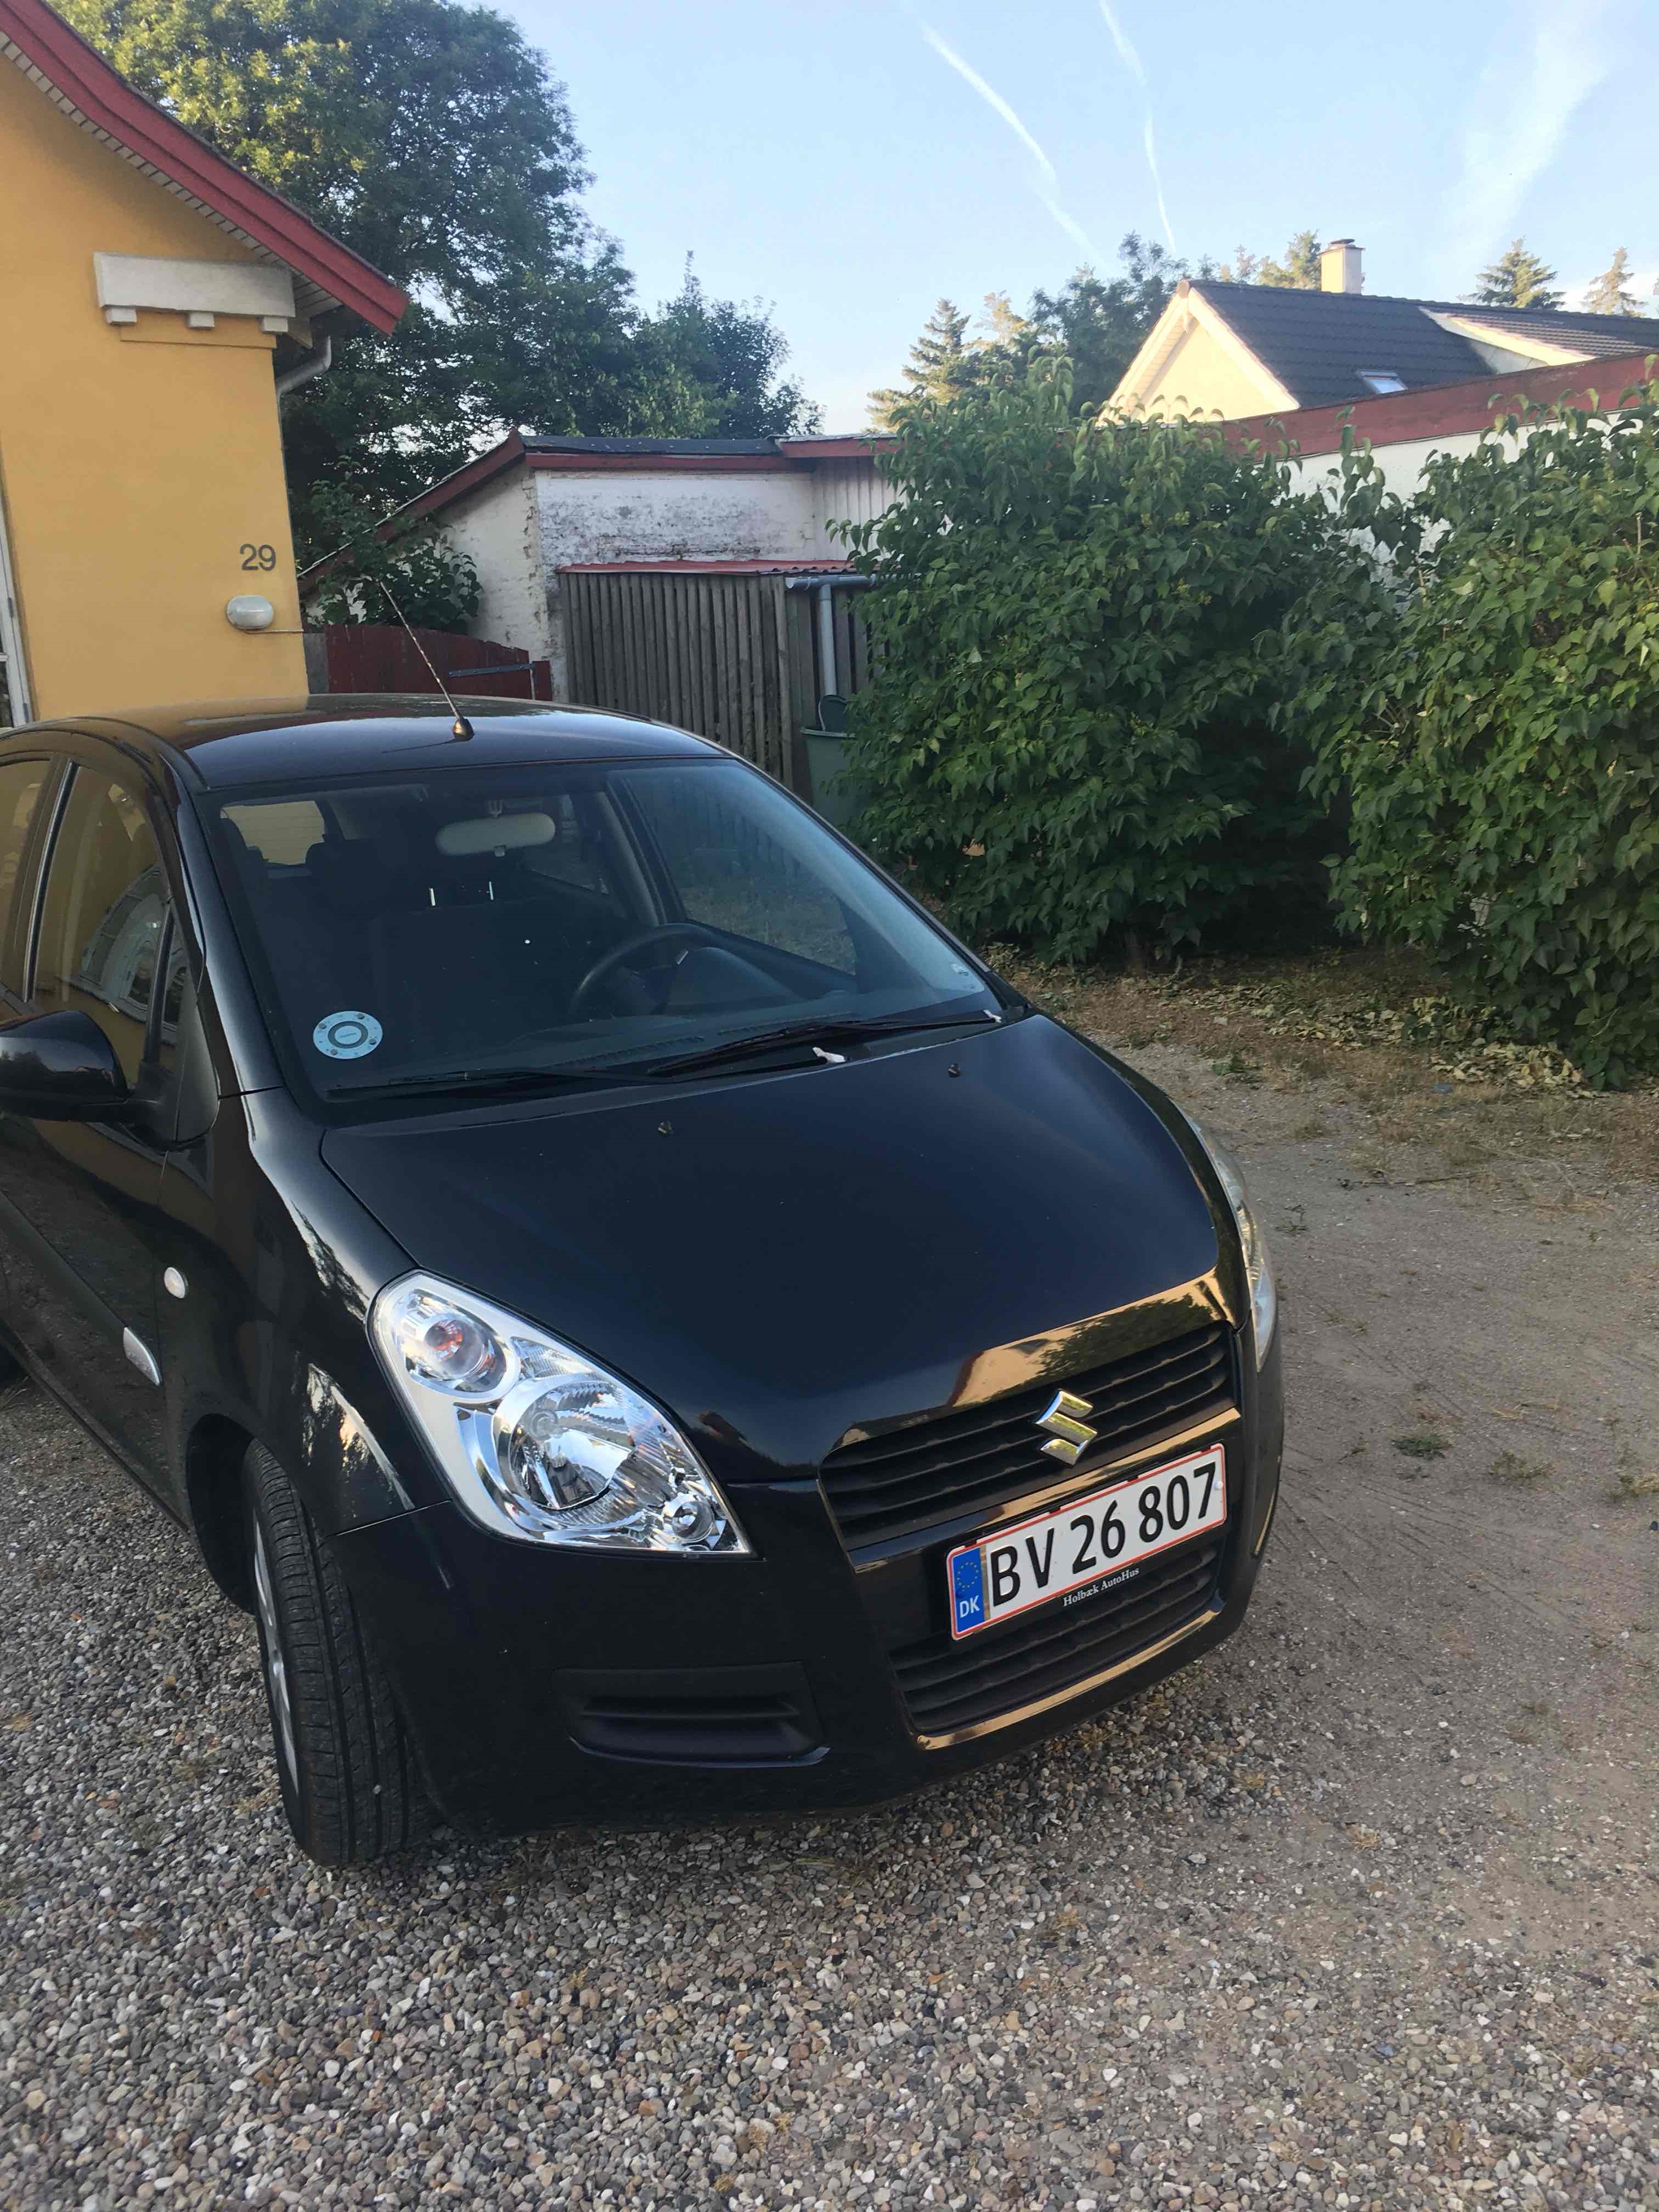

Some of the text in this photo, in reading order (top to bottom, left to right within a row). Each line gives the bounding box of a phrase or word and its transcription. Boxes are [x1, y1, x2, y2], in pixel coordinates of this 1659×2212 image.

[240, 544, 276, 571] 29
[990, 1462, 1216, 1606] BV 26 807
[1063, 1568, 1139, 1606] Holbæk AutoHus
[960, 1595, 980, 1618] DK
